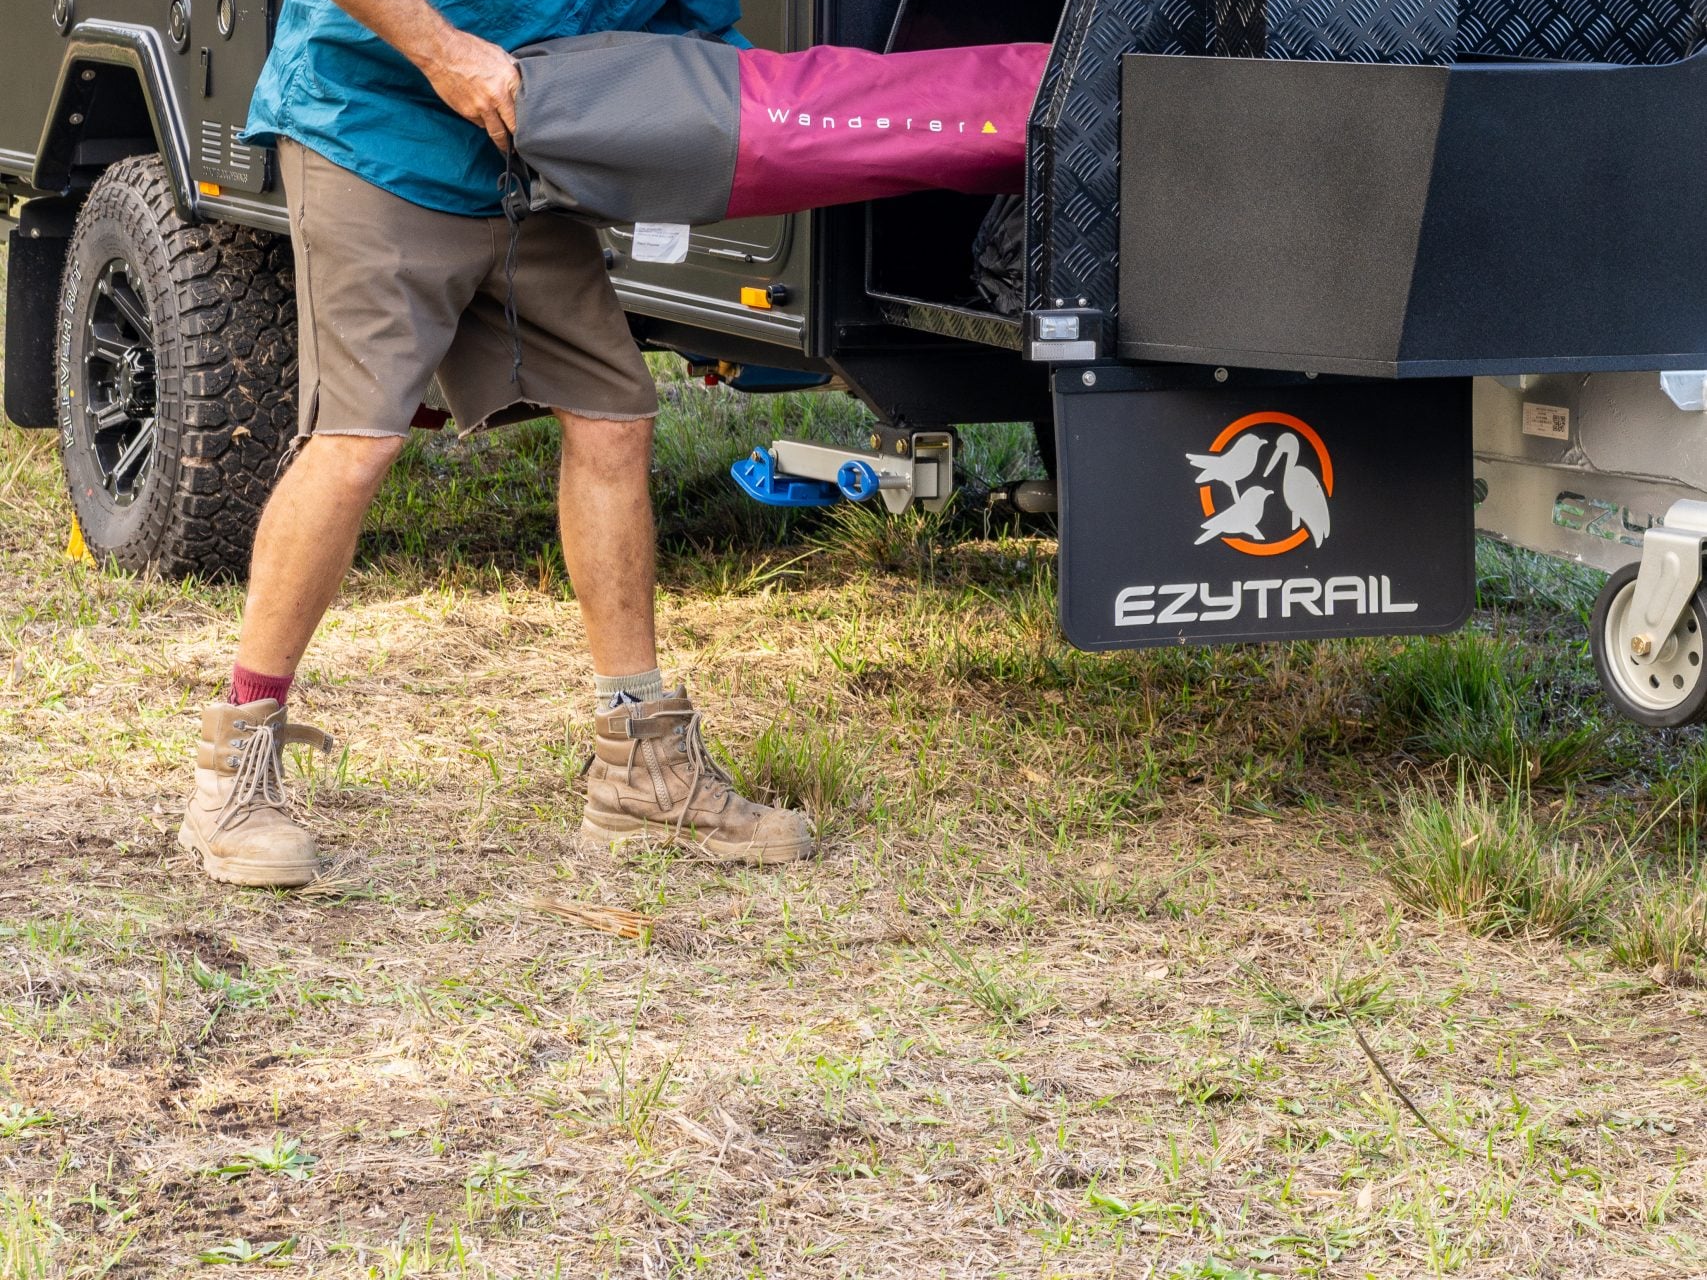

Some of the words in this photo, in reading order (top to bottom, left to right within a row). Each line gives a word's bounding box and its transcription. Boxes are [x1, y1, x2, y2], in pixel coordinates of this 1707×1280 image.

[767, 107, 965, 133] Wanderer
[65, 260, 82, 315] R/T
[60, 318, 75, 449] KLEVER
[1114, 575, 1419, 627] EZYTRAIL
